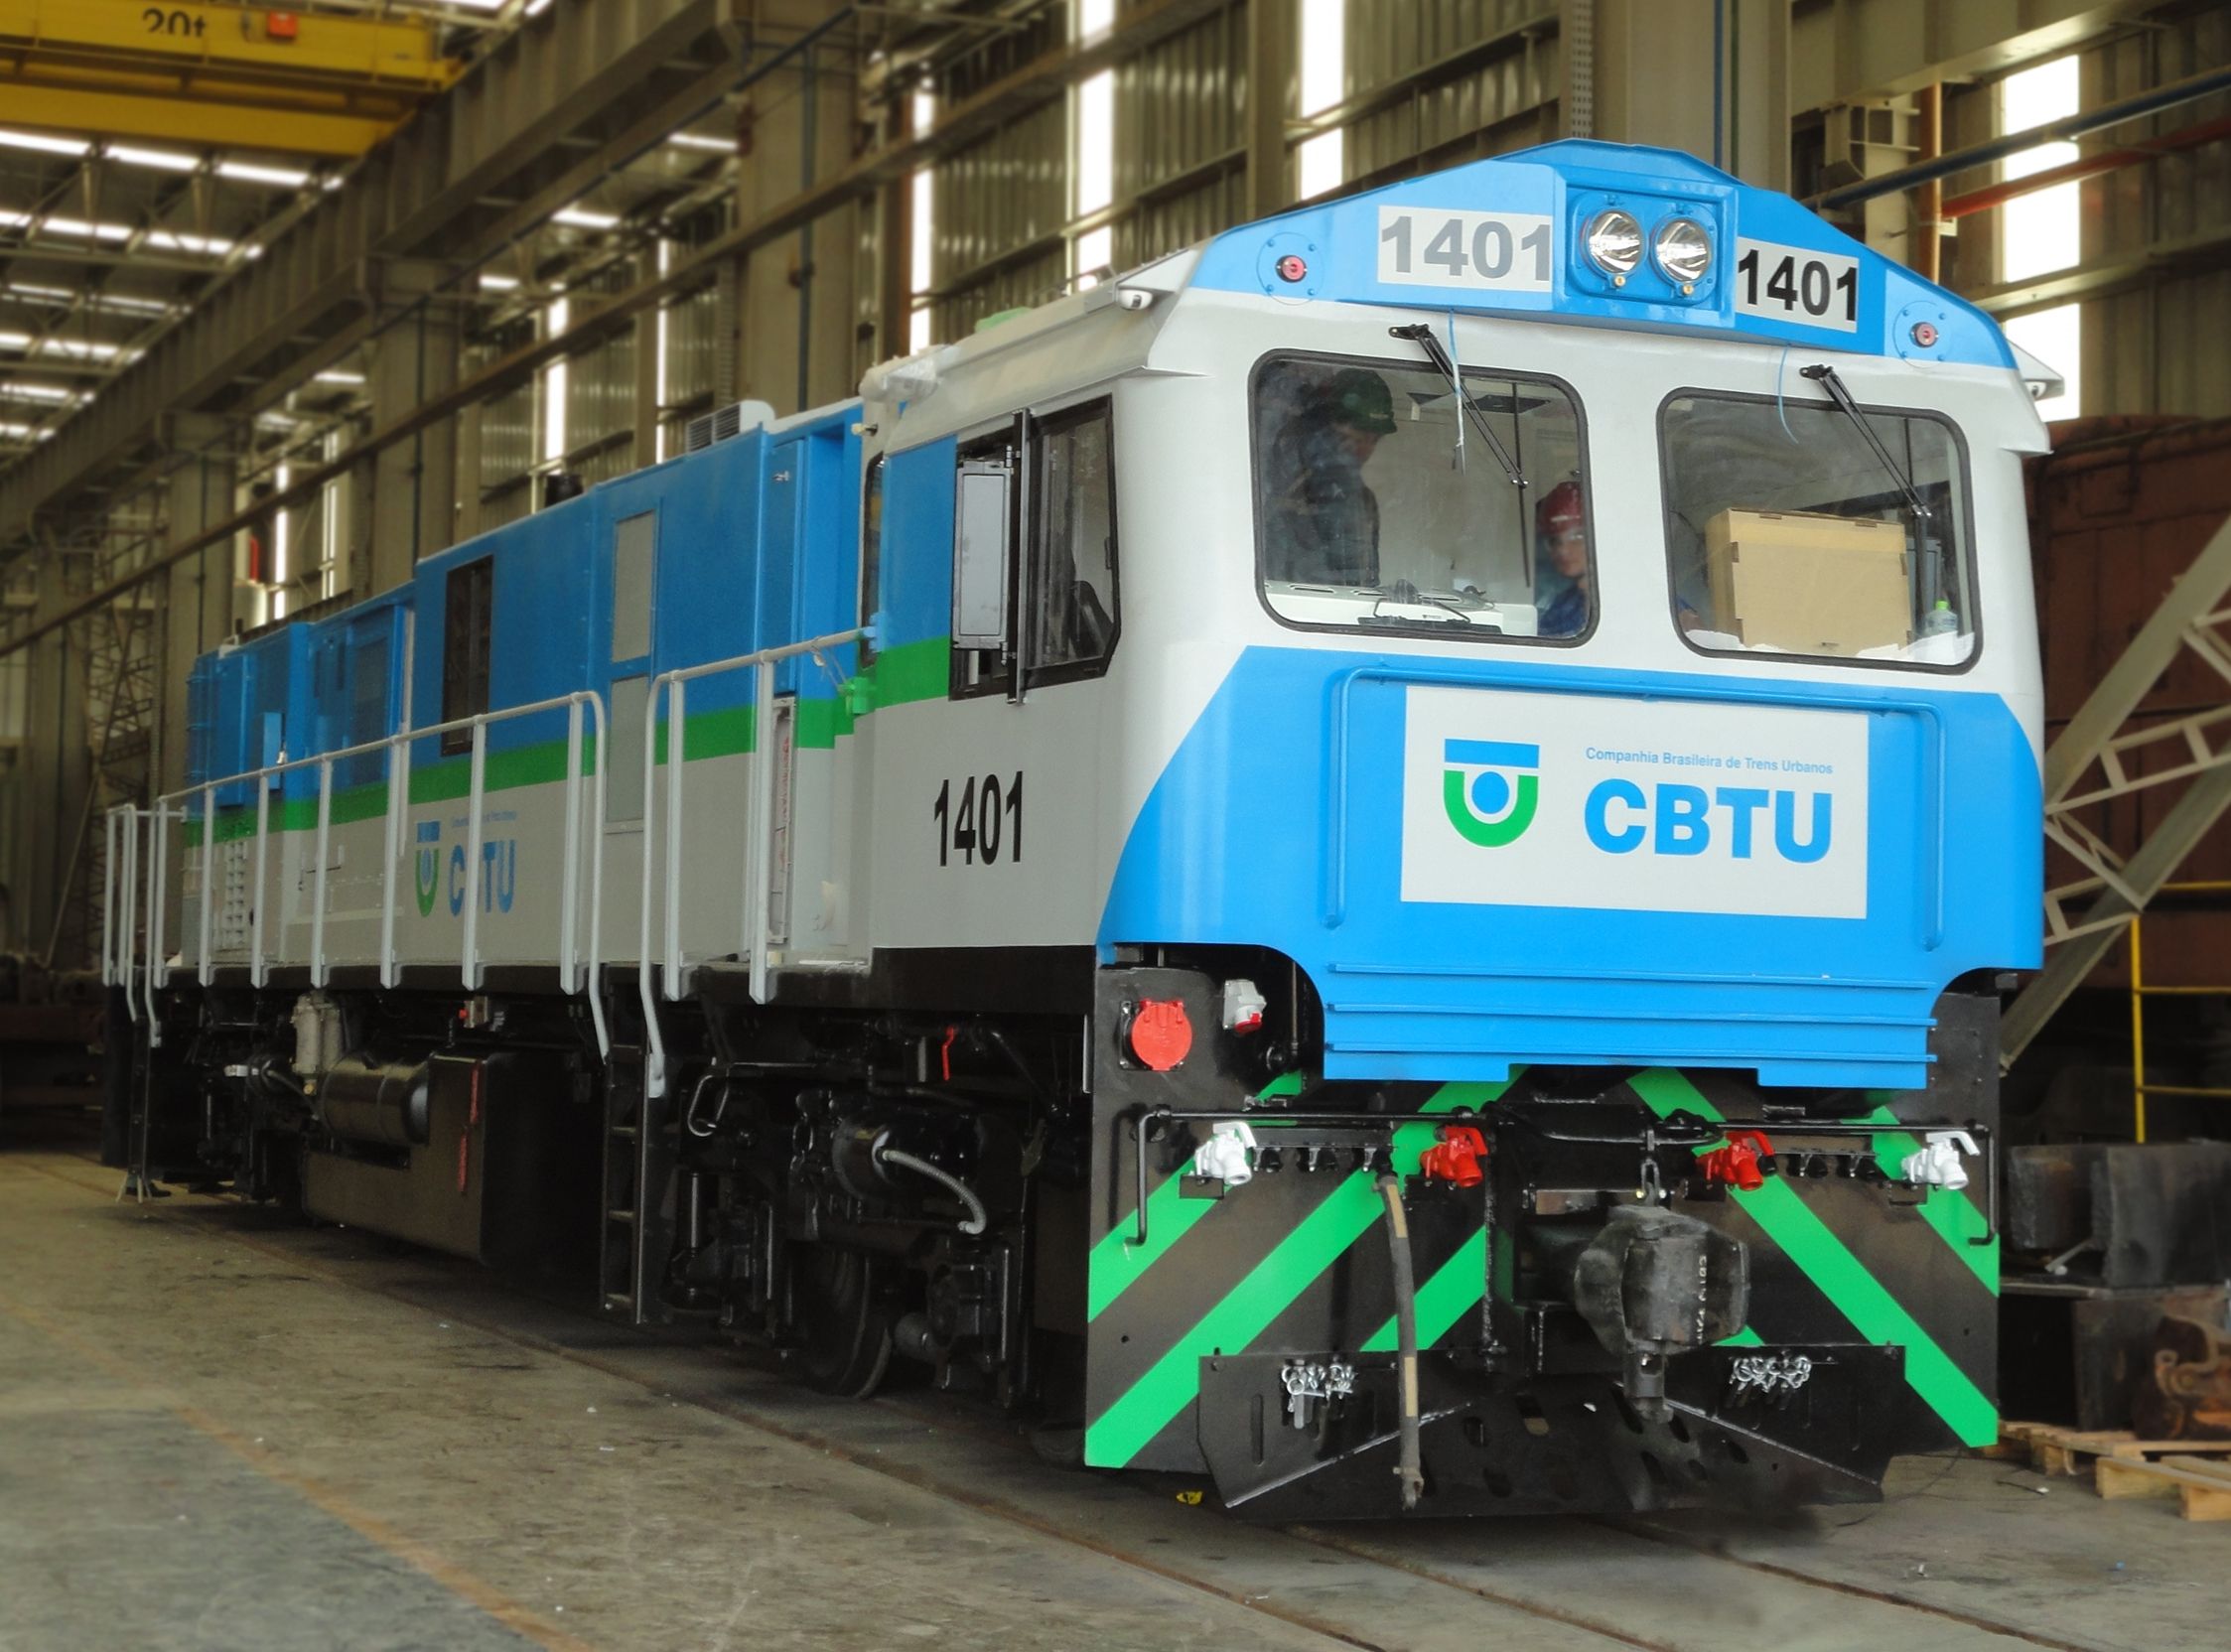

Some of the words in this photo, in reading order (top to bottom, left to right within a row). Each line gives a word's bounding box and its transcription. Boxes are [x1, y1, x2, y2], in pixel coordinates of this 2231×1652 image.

[1381, 215, 1550, 281] 1401
[1738, 248, 1858, 322] 1401
[1586, 747, 1659, 763] Companhia
[1662, 753, 1722, 768] Brasileira
[1726, 757, 1741, 769] de
[1744, 757, 1778, 771] Trens
[1781, 760, 1833, 774] Urbanos
[934, 770, 1024, 867] 1401
[1584, 778, 1833, 864] CBTU
[448, 839, 516, 917] CTU
